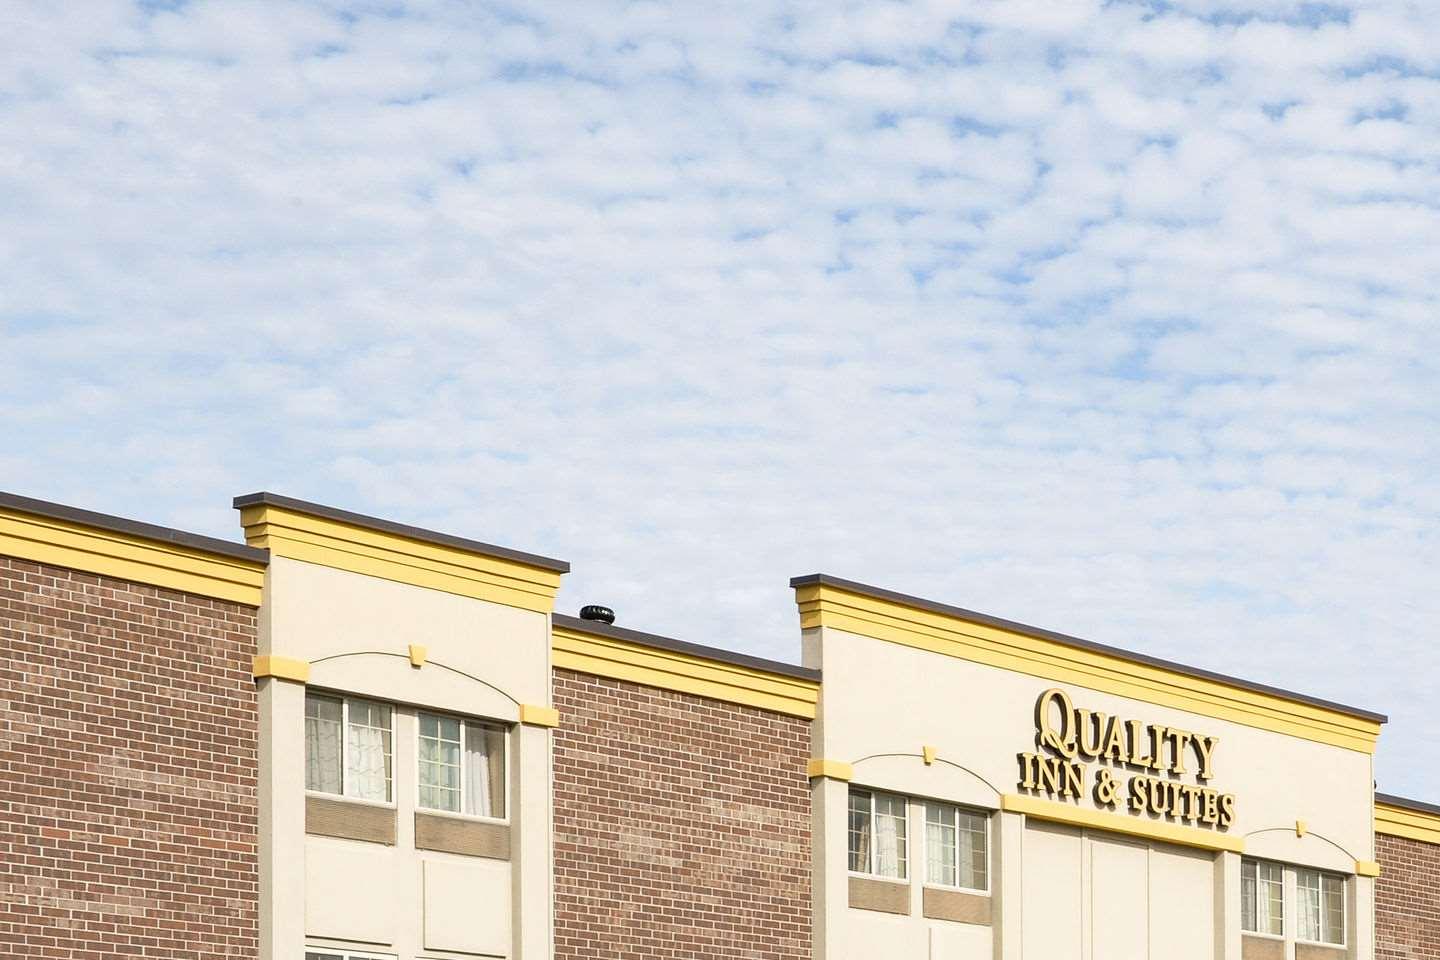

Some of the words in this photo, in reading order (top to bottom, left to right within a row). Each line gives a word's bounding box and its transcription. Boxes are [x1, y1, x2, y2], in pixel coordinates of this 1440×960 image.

[1036, 688, 1219, 782] QUALITY
[1019, 751, 1087, 801] INN
[1094, 768, 1122, 808] &
[1129, 774, 1236, 829] SUITES
